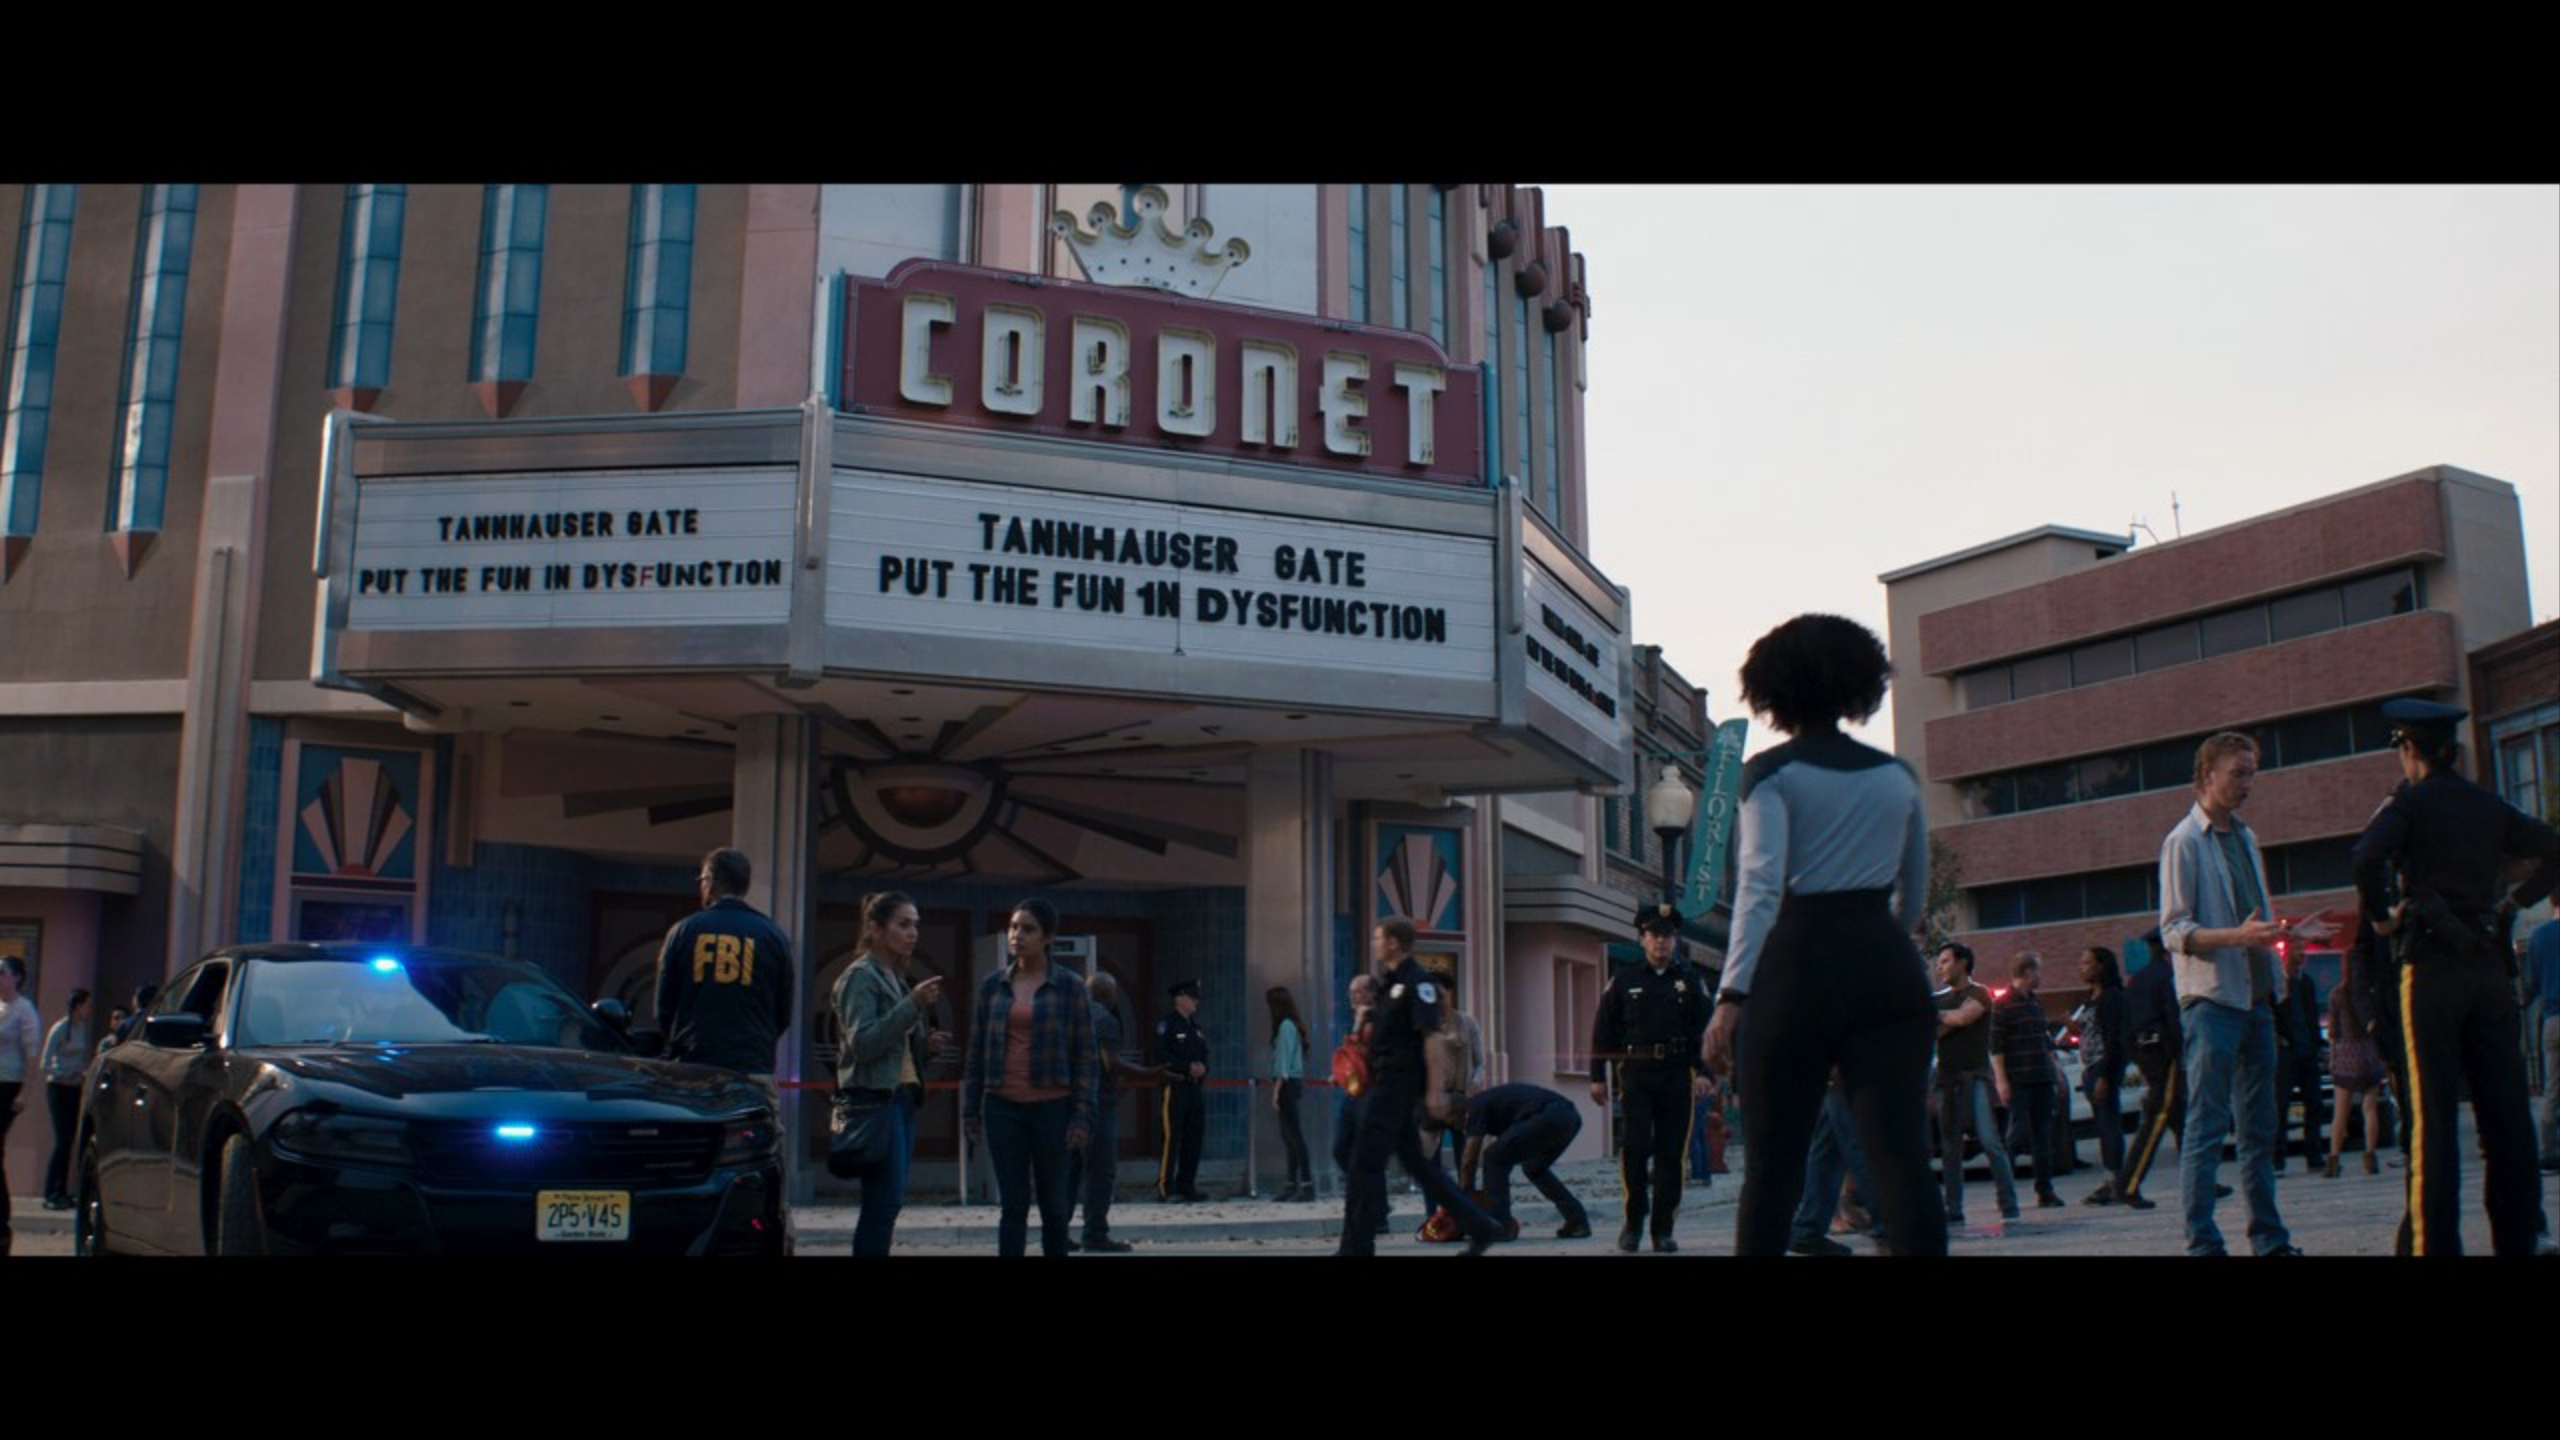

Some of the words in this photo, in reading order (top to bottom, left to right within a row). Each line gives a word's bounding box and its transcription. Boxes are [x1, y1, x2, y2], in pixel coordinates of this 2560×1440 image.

[900, 294, 1447, 466] CORONET
[438, 514, 614, 541] TANNHAUSER
[626, 510, 698, 536] GATE
[978, 513, 1240, 574] TANNHAUSER
[1275, 545, 1367, 588] GATE
[360, 569, 408, 593] PUT
[422, 568, 467, 592] THE
[481, 566, 531, 592] FUN
[545, 565, 571, 590] IN
[583, 561, 782, 590] DYSFUNCTION
[878, 556, 953, 599] PUT
[968, 564, 1038, 607] THE
[1053, 572, 1125, 613] FUN
[1197, 588, 1447, 643] DYSFUNCTION
[1697, 751, 1735, 900] FLORIST
[694, 934, 755, 986] FBI
